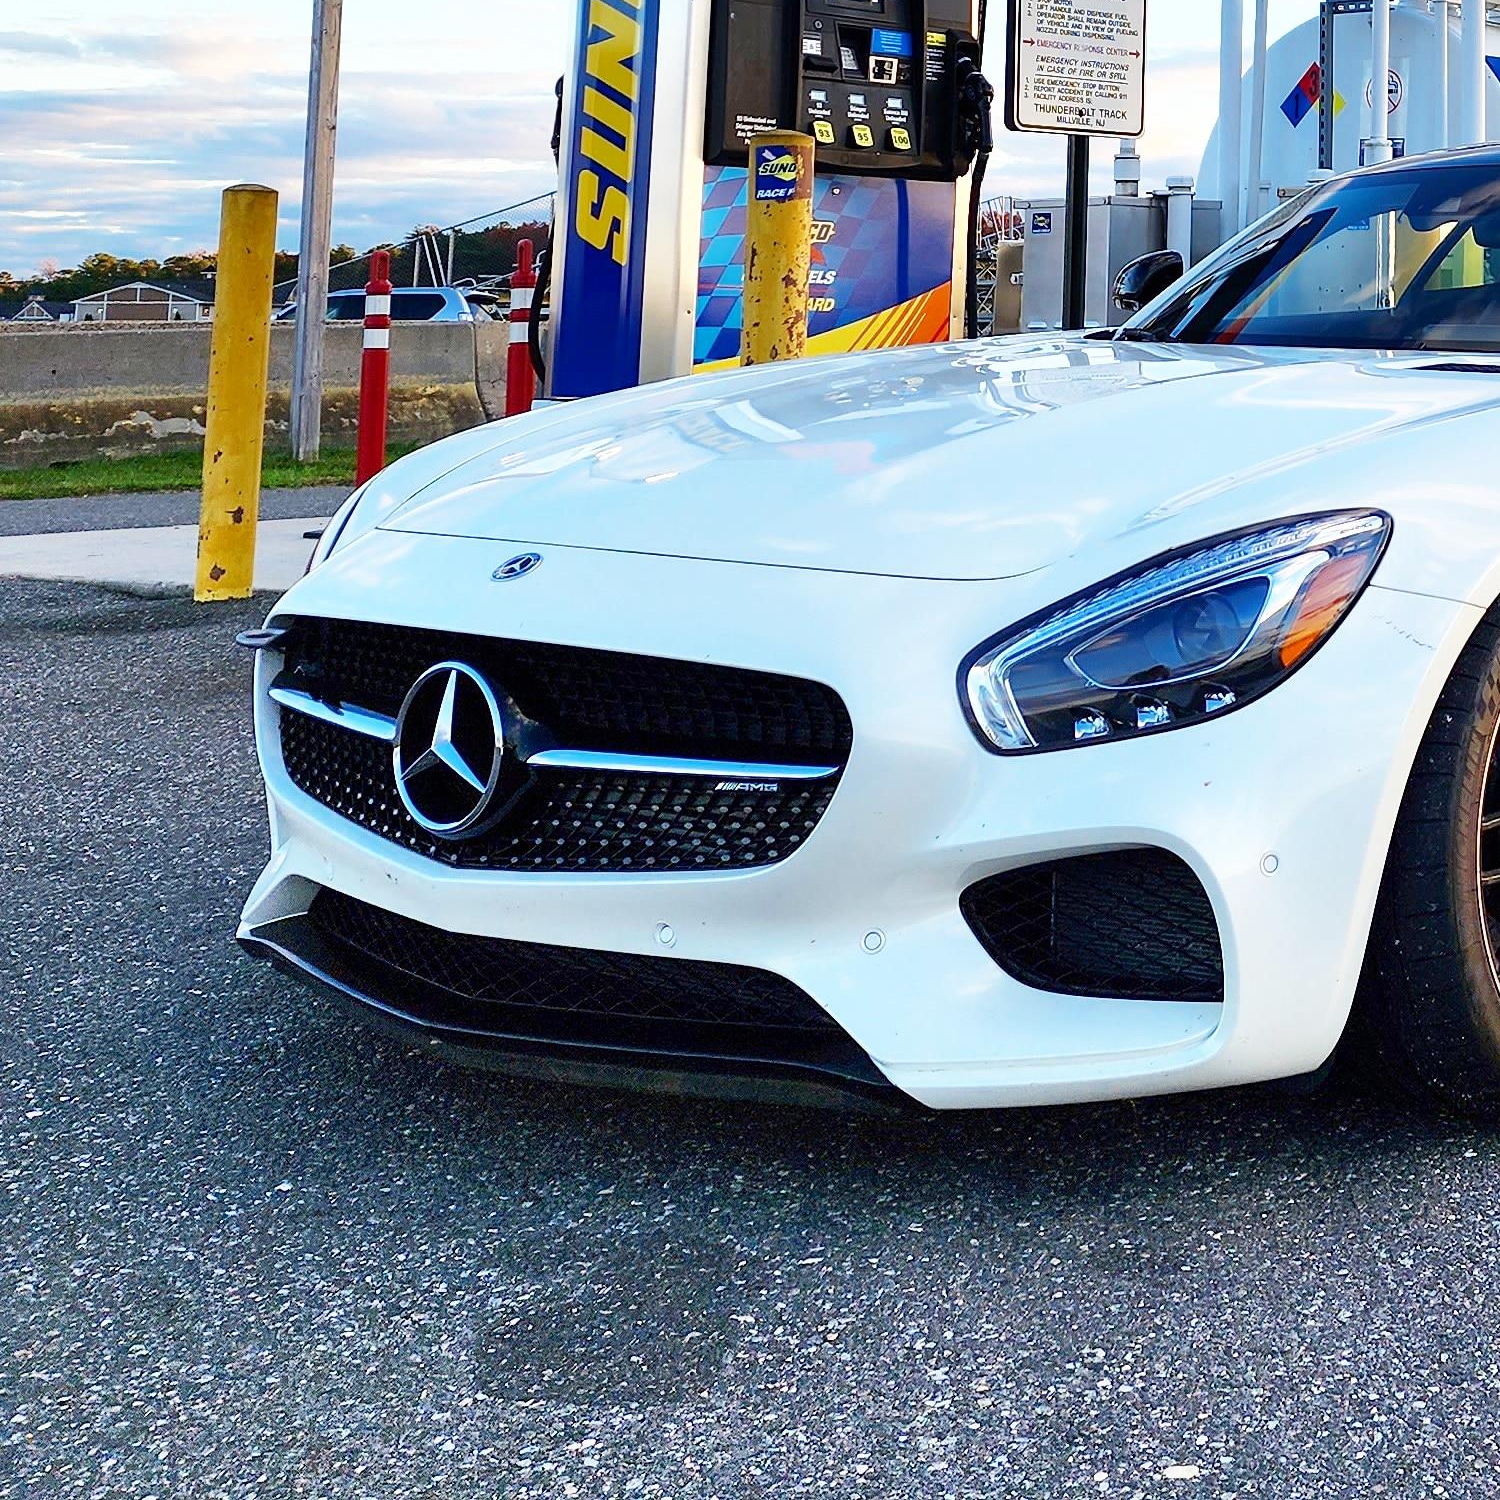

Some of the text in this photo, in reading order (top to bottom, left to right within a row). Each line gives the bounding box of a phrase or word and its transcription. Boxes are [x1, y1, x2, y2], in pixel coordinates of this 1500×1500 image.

[1037, 10, 1131, 28] OPERATOR SHALL REMAIN OUTSIDE
[1050, 5, 1072, 13] HANDLE
[1087, 10, 1113, 19] DISPENSE
[1036, 26, 1058, 34] NOZZLE
[1060, 29, 1080, 37] DURING
[1047, 19, 1069, 28] VEHICLE
[1116, 28, 1138, 37] FUELING
[1036, 39, 1128, 57] EMERGENCY CENTER
[1036, 54, 1129, 72] EMERGENCY INSTRUCTIONS
[1047, 65, 1065, 74] CASE
[1079, 69, 1094, 77] FIRE
[1109, 72, 1126, 81] SPILL
[1034, 77, 1119, 92] USE EMERGENCY STOP BUTTON
[1308, 69, 1319, 97] 3
[1033, 85, 1055, 93] REPORT
[1057, 87, 1083, 96] ACCIDENT
[1094, 91, 1117, 99] CALLING
[1033, 92, 1083, 103] FACILITY ADDRESS
[1034, 101, 1127, 120] THUNDERBOLT TRACK
[1056, 115, 1105, 127] MILLVILLE, NJ
[817, 129, 831, 139] 93
[857, 132, 869, 142] 95
[893, 135, 909, 145] 100
[760, 162, 797, 175] SUNO
[756, 188, 787, 199] RACE
[809, 270, 837, 285] ELS
[735, 782, 778, 792] AMG
